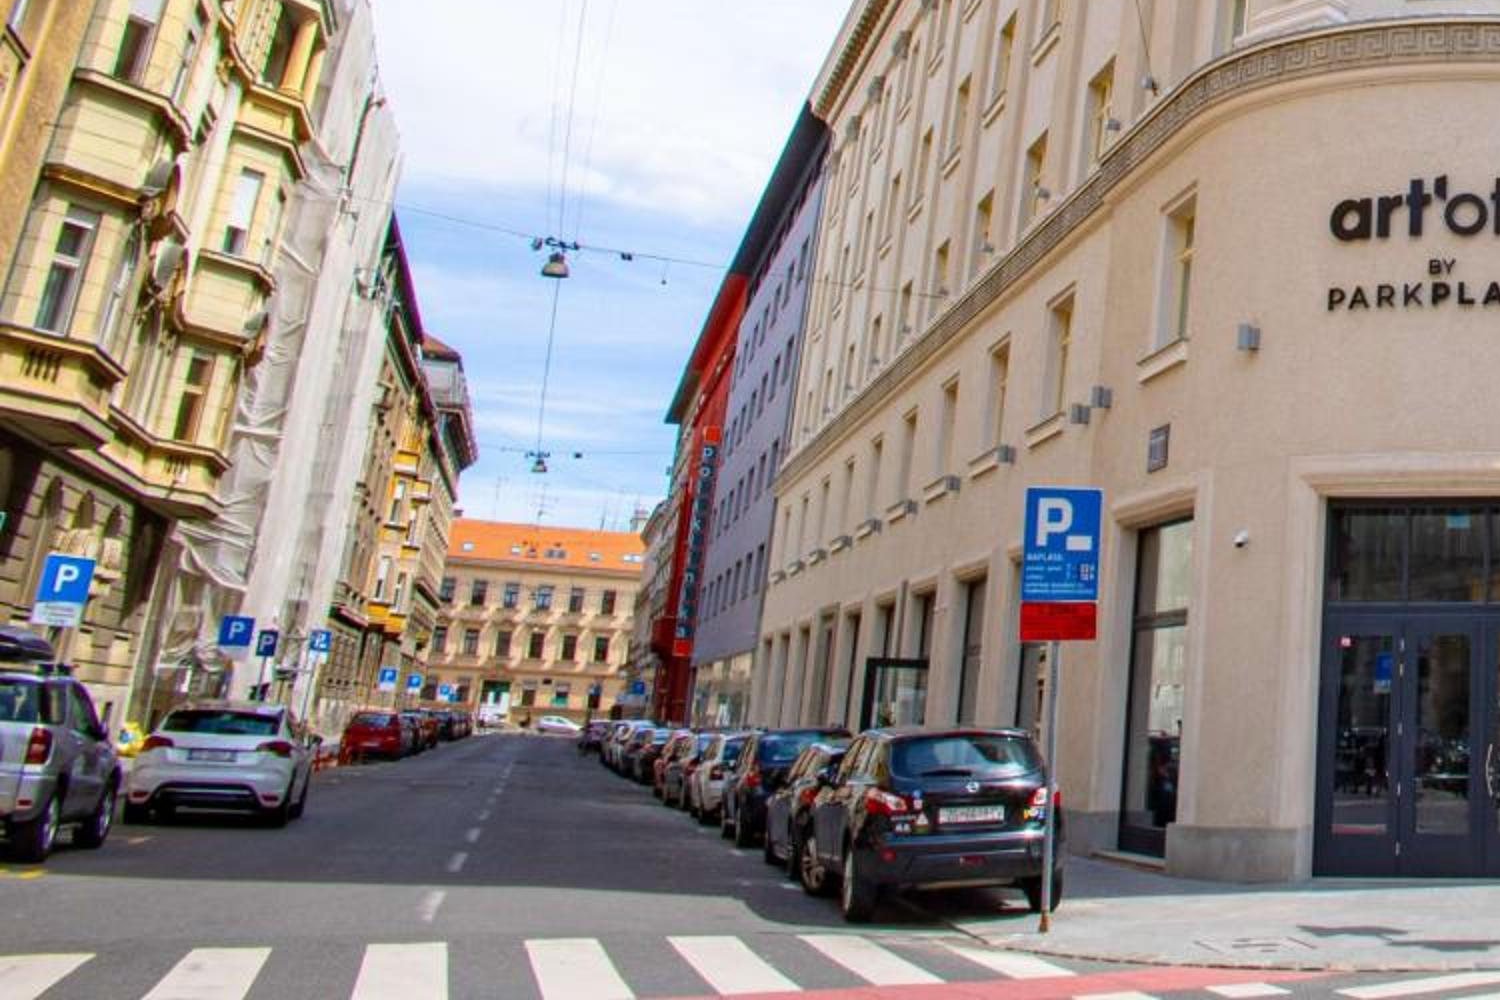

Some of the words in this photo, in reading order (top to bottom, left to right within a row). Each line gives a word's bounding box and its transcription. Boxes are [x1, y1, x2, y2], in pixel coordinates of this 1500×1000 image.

[1428, 258, 1456, 275] BY
[1035, 497, 1073, 547] P
[53, 564, 79, 593] P
[227, 620, 246, 641] P
[259, 633, 275, 653] P
